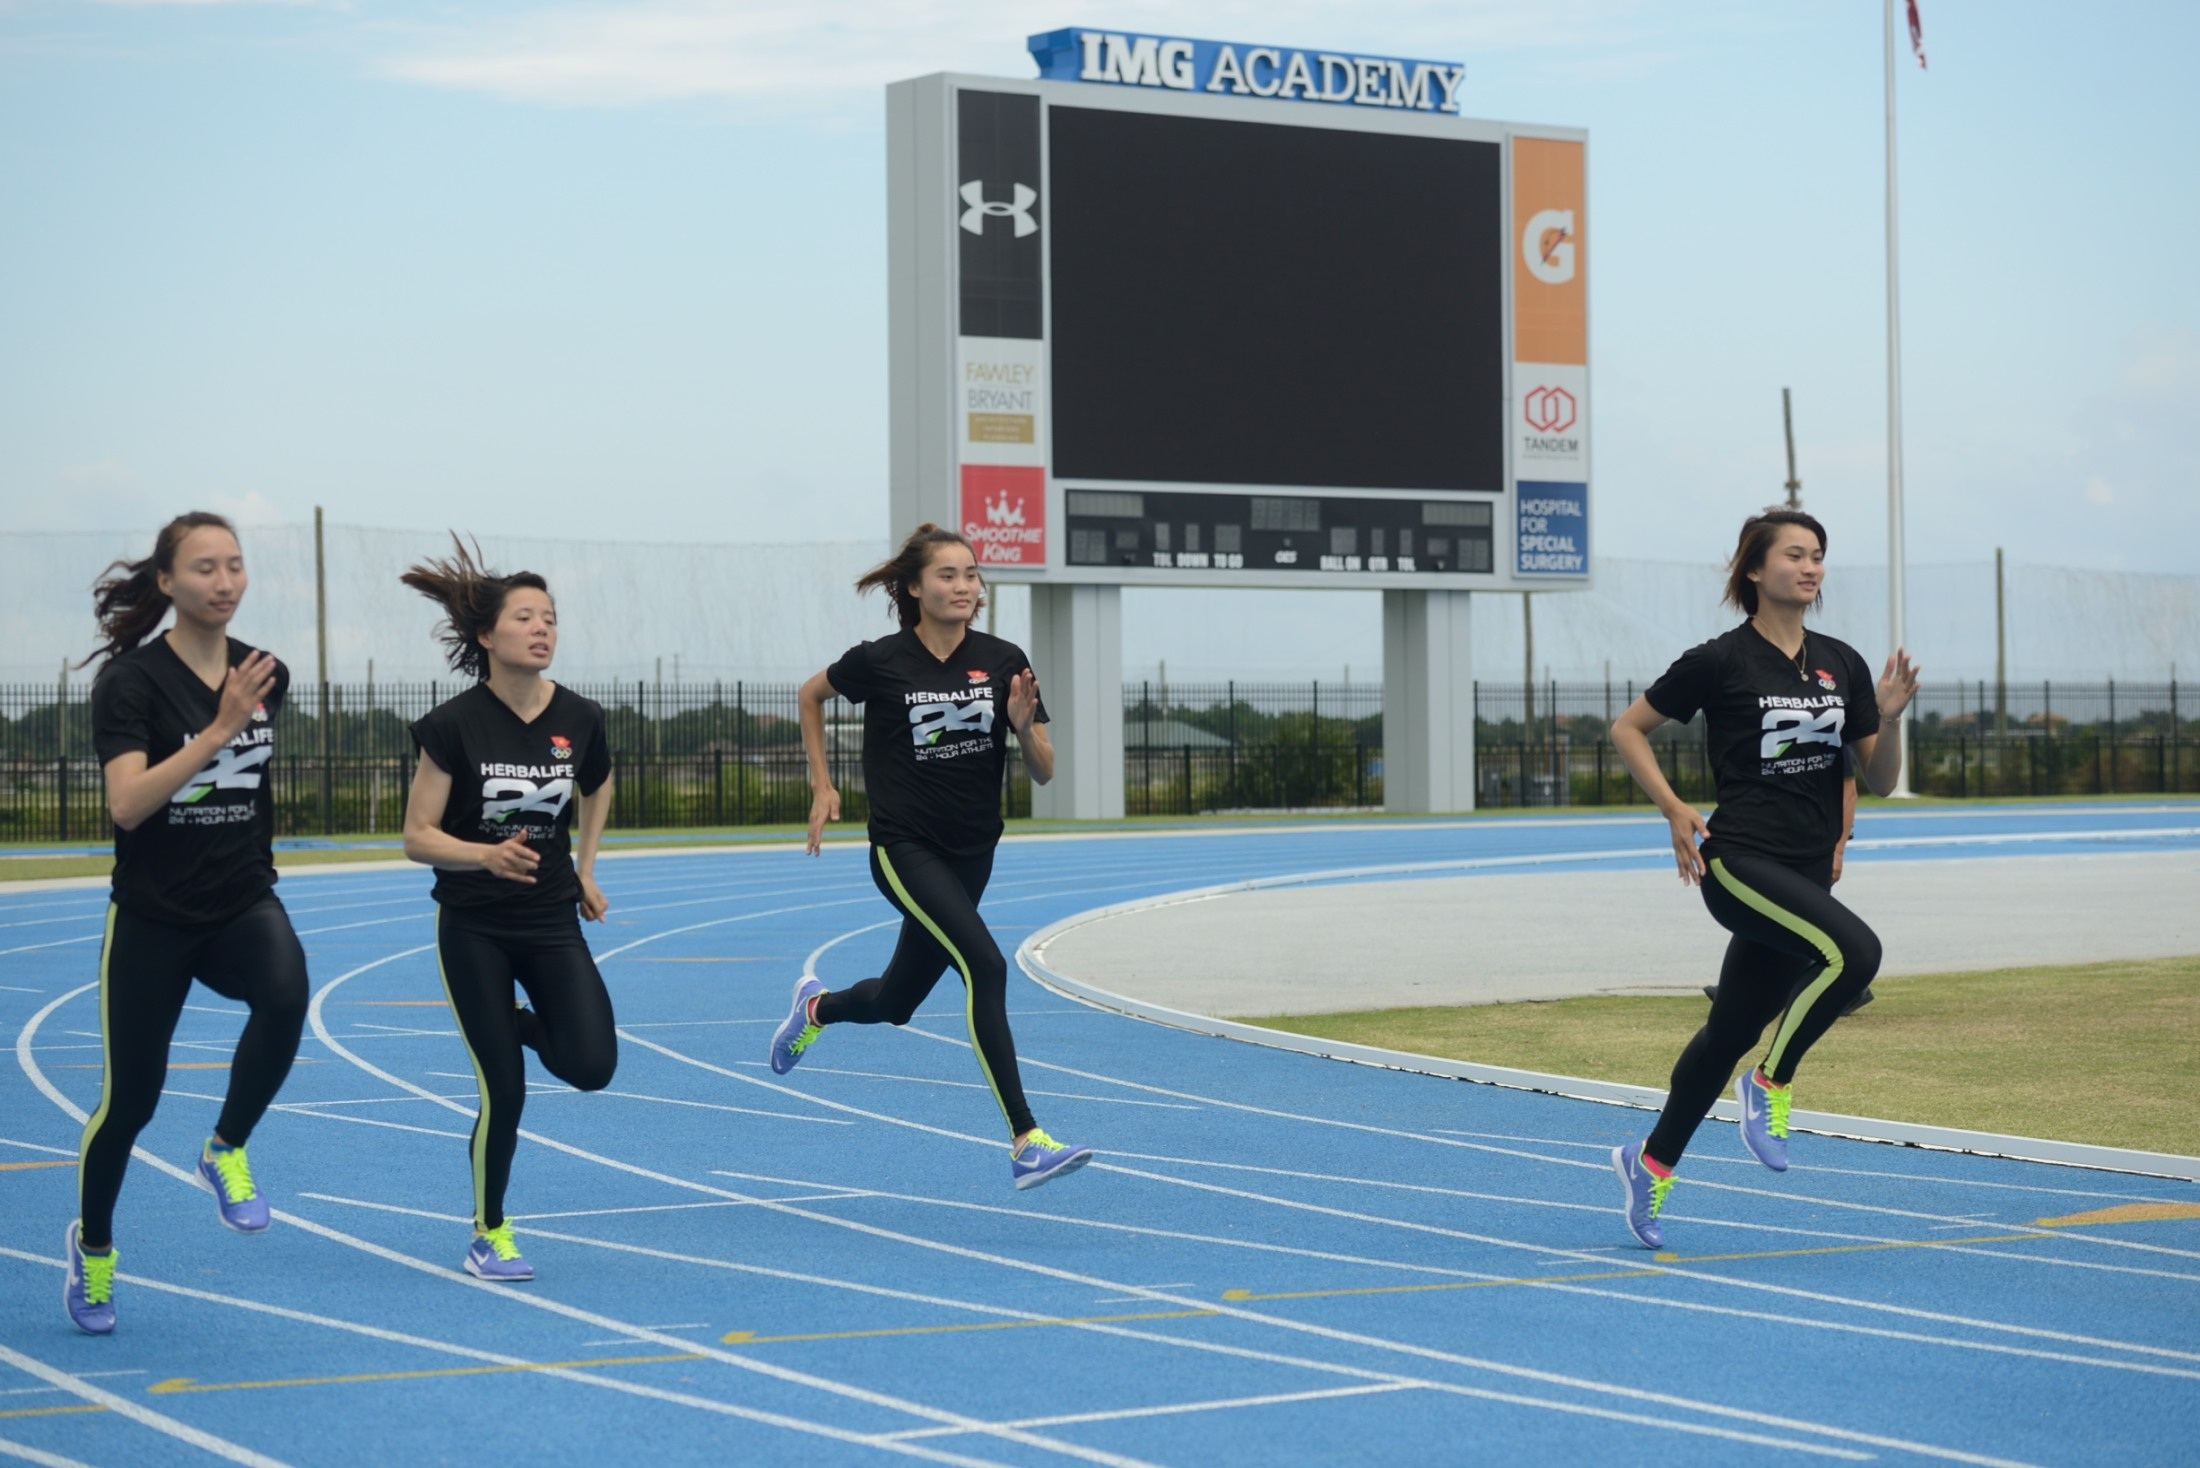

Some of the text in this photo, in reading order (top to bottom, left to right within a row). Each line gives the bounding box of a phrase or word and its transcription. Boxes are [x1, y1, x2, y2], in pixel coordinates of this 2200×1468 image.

[1081, 32, 1466, 112] IMG ACADEMY
[1522, 209, 1576, 285] G
[966, 361, 1034, 385] FAWLEY
[967, 389, 1033, 410] BRYANT
[1523, 437, 1579, 453] TANDEM
[1520, 499, 1583, 517] HOSPITAL
[964, 521, 1043, 544] SMOOTHIE
[1520, 517, 1548, 533] FOR
[1520, 535, 1577, 552] SPECIAL
[981, 543, 1022, 562] KING
[1177, 552, 1209, 567] DOWN
[1213, 553, 1243, 568] TO GO
[1320, 555, 1345, 571] BALL
[1520, 553, 1584, 570] SURGERY
[905, 687, 994, 705] HERBALIFE
[1758, 695, 1845, 709] HERBALIFE
[909, 700, 995, 746] 24
[184, 728, 274, 748] HALIFE
[1760, 708, 1845, 758] 24
[914, 742, 959, 755] NUTRITION
[960, 739, 977, 748] FOR
[935, 749, 959, 759] HOUR
[1807, 755, 1822, 764] FOR
[481, 762, 574, 778] HERBALIFE
[1782, 765, 1806, 774] HOUR
[481, 778, 573, 821] 24
[169, 806, 226, 816] NUTRITION
[228, 804, 248, 814] FOR
[195, 815, 225, 825] HOUR
